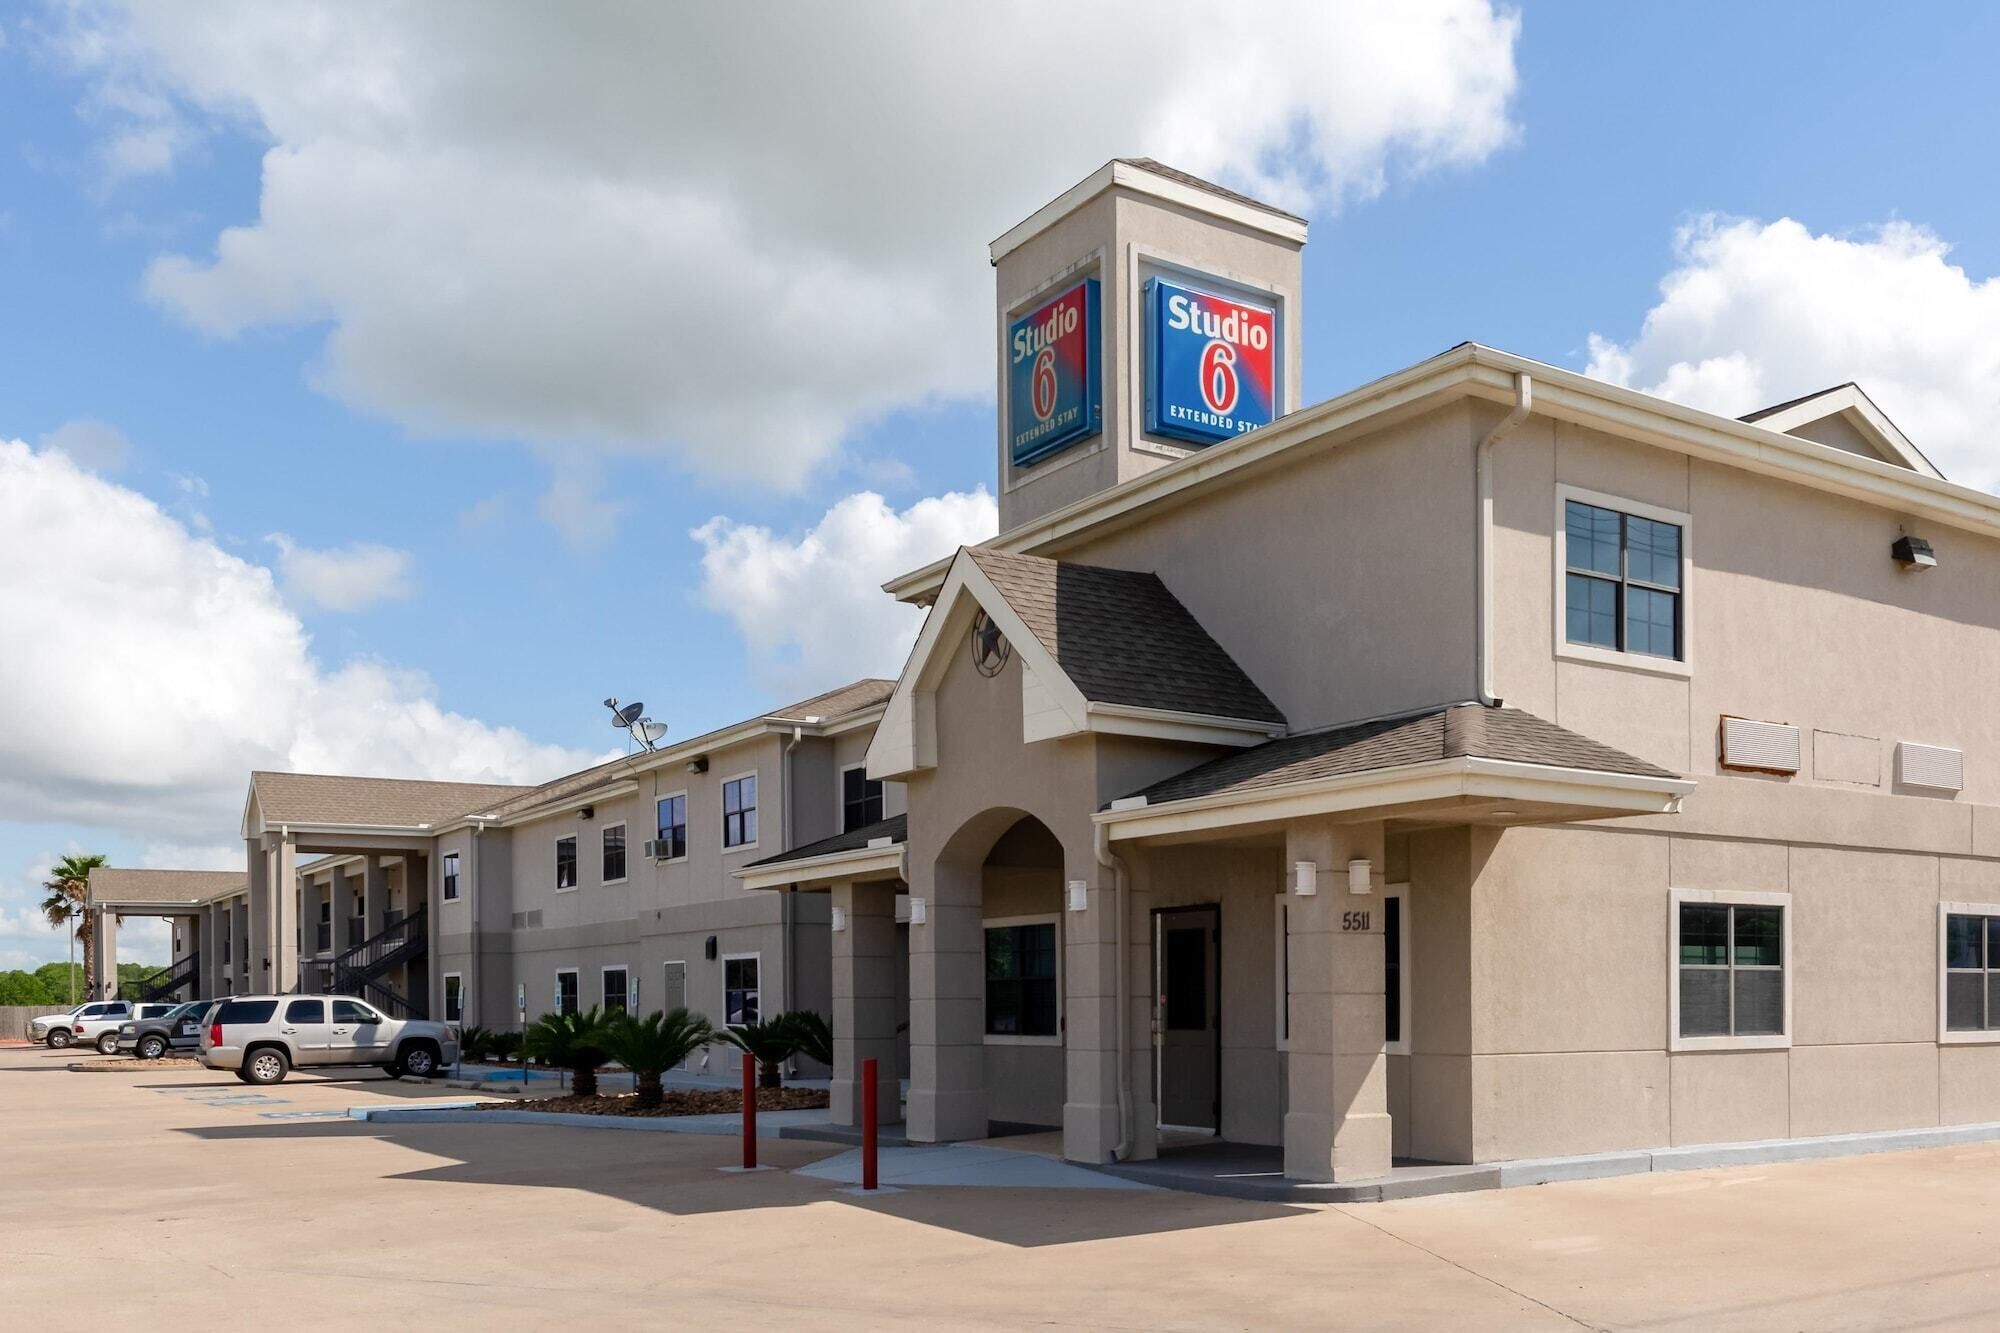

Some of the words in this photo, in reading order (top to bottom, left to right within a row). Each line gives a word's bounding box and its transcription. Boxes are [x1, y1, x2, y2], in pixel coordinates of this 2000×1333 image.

[1014, 302, 1078, 364] Studio
[1168, 295, 1268, 351] Studio
[1032, 345, 1057, 421] 6
[1200, 339, 1239, 415] 6
[1016, 418, 1055, 447] EXTENDED
[1057, 406, 1078, 426] STAY
[1170, 405, 1233, 429] EXTENDED
[1237, 420, 1263, 433] STA
[1342, 911, 1370, 931] 5511
